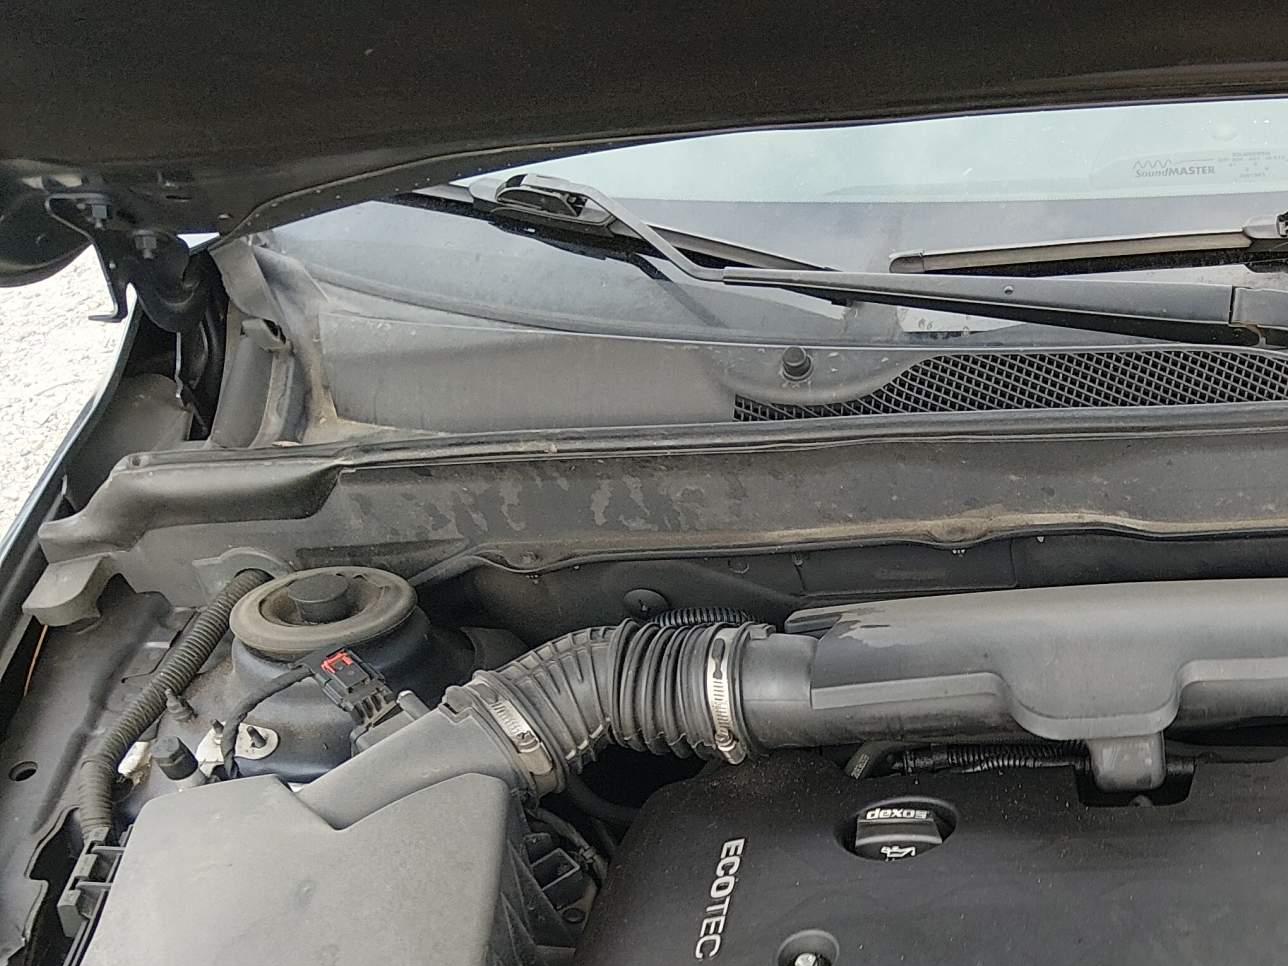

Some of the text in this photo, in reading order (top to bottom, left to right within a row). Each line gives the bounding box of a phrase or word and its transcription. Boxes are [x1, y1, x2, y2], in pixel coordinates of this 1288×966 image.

[1135, 165, 1215, 178] SoundMASTER
[866, 807, 929, 820] dexos
[695, 838, 745, 959] ECOTEC
